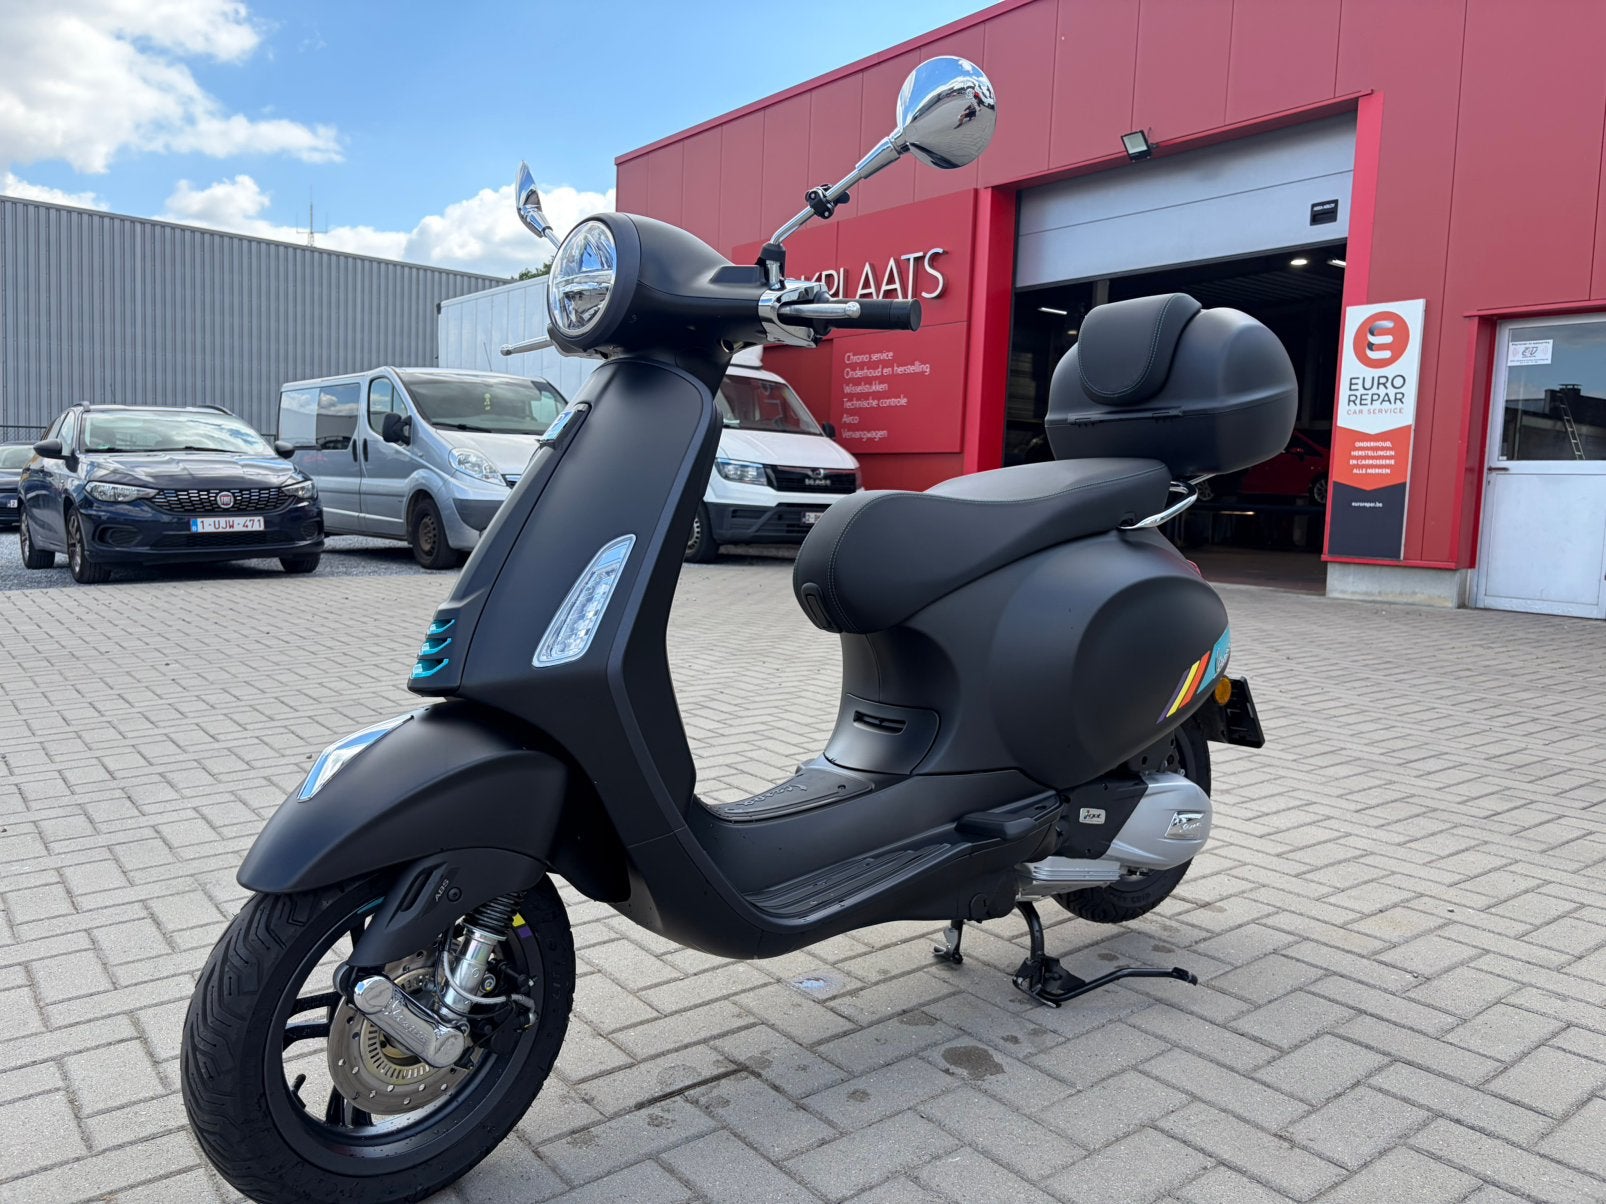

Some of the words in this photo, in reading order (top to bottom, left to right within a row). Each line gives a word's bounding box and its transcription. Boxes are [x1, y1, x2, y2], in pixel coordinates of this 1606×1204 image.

[844, 352, 869, 364] Chrono
[870, 350, 894, 361] service
[844, 364, 882, 379] Onderhoud
[883, 367, 892, 376] en
[893, 361, 930, 375] herstelling
[843, 380, 889, 394] Wisselstukken
[1349, 374, 1406, 391] EURO
[843, 396, 879, 409] Technische
[879, 394, 908, 407] controle
[1347, 391, 1405, 406] REPAR
[1346, 408, 1364, 416] CAR
[1367, 407, 1404, 415] SERVICE
[842, 414, 859, 424] Airco
[841, 428, 888, 442] Vervangwagen
[200, 518, 262, 530] 1-UJW-471
[435, 878, 449, 902] ABS
